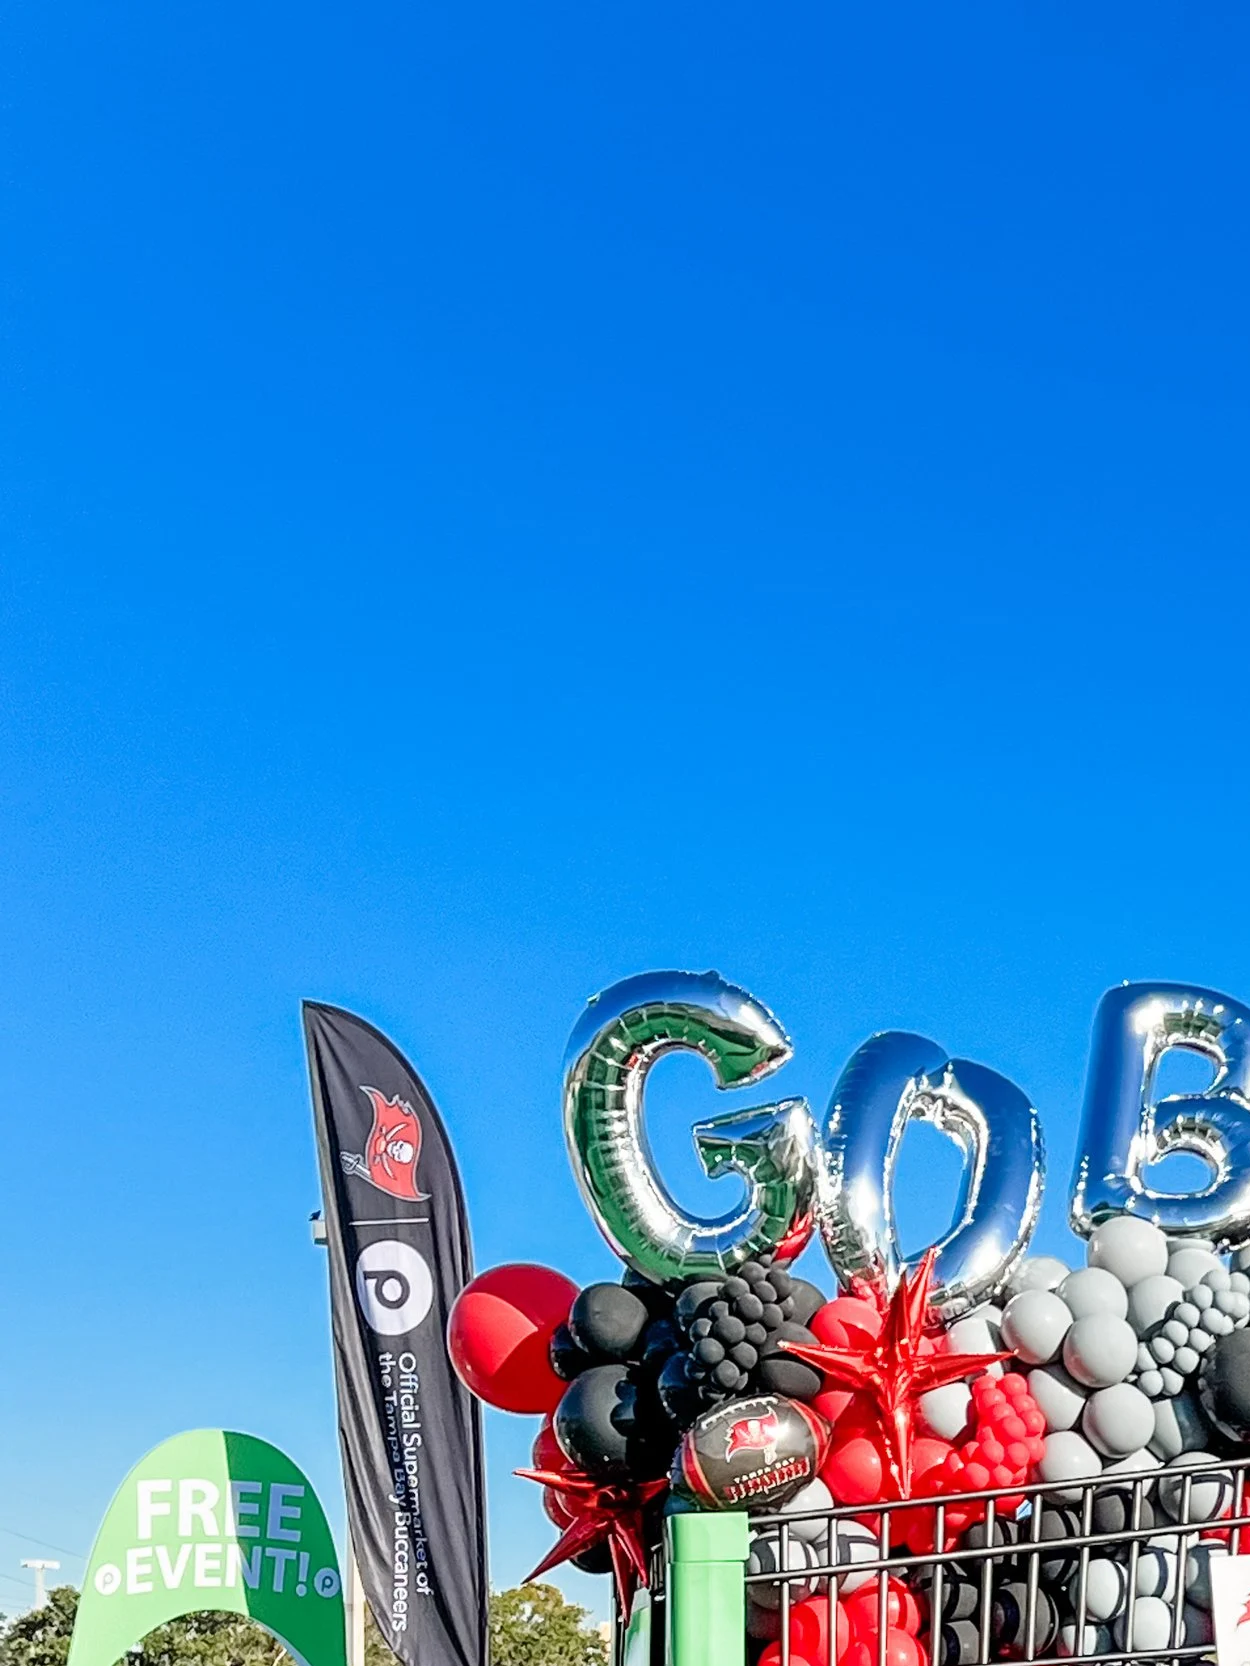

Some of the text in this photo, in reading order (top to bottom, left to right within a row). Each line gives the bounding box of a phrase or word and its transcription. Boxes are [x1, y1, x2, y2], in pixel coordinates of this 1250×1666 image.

[563, 969, 1047, 1316] GO
[126, 1543, 310, 1597] EVENT!
[136, 1478, 305, 1542] FREE
[379, 1352, 411, 1632] the Tampa Bay Buccaneers
[398, 1352, 434, 1596] Official Supermarket of
